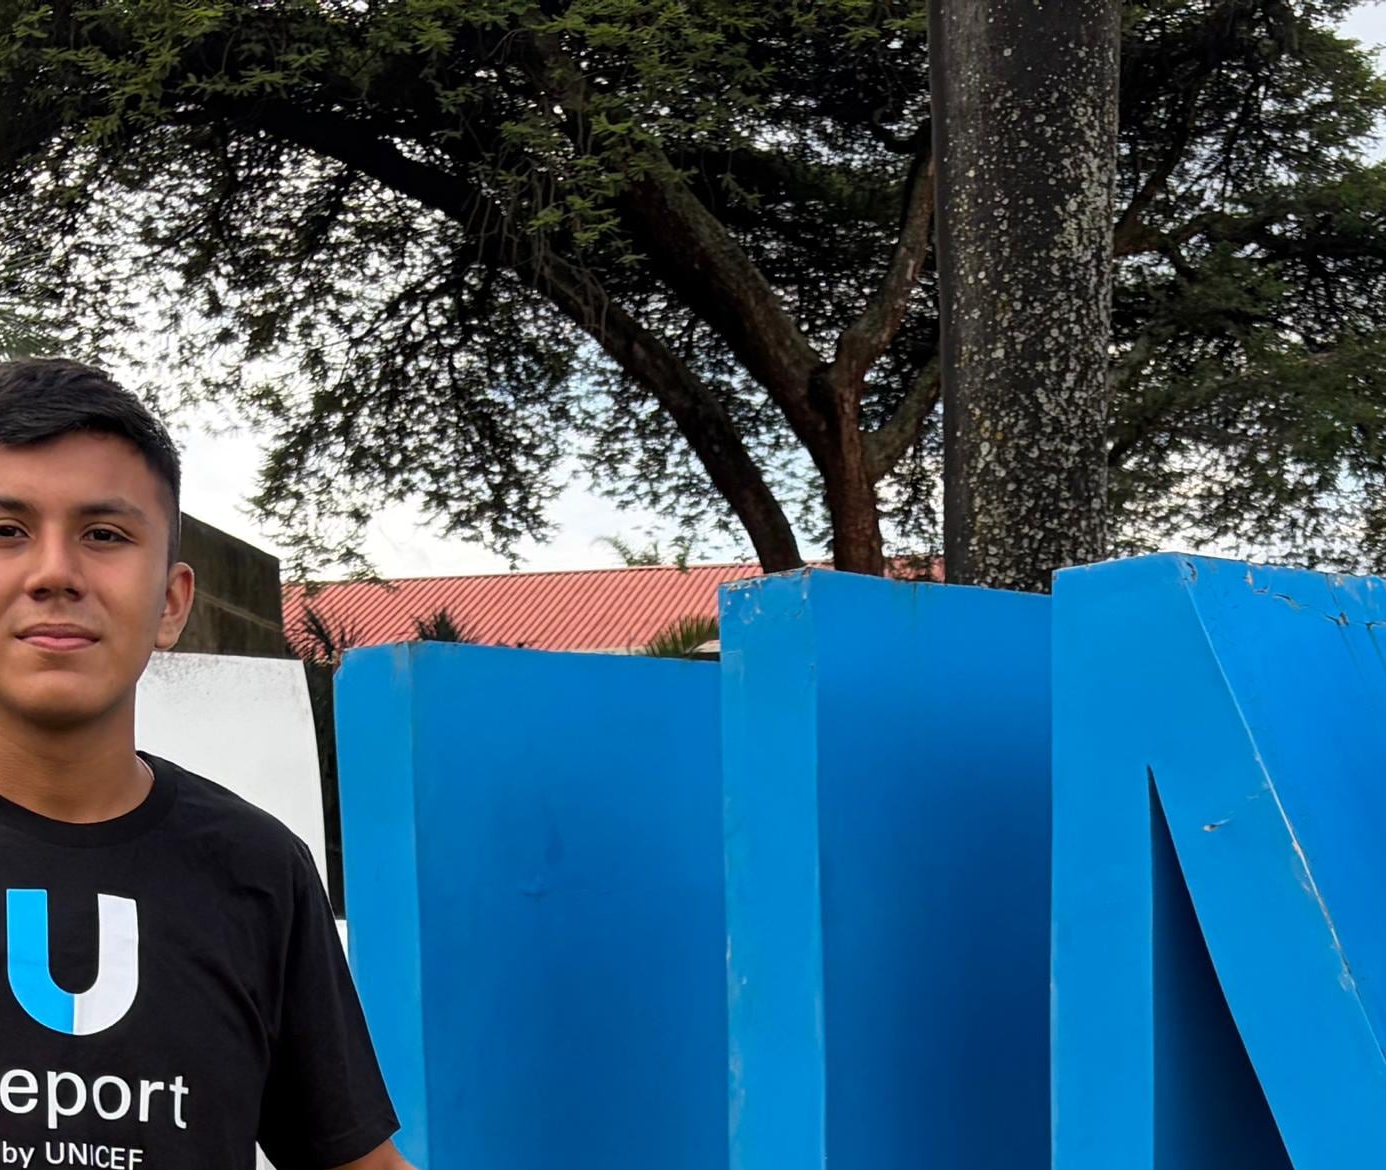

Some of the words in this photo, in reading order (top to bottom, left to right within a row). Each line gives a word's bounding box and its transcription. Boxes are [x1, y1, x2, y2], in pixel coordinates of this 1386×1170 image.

[6, 888, 139, 1036] U
[2, 1140, 35, 1169] by
[45, 1141, 144, 1170] UNICEF
